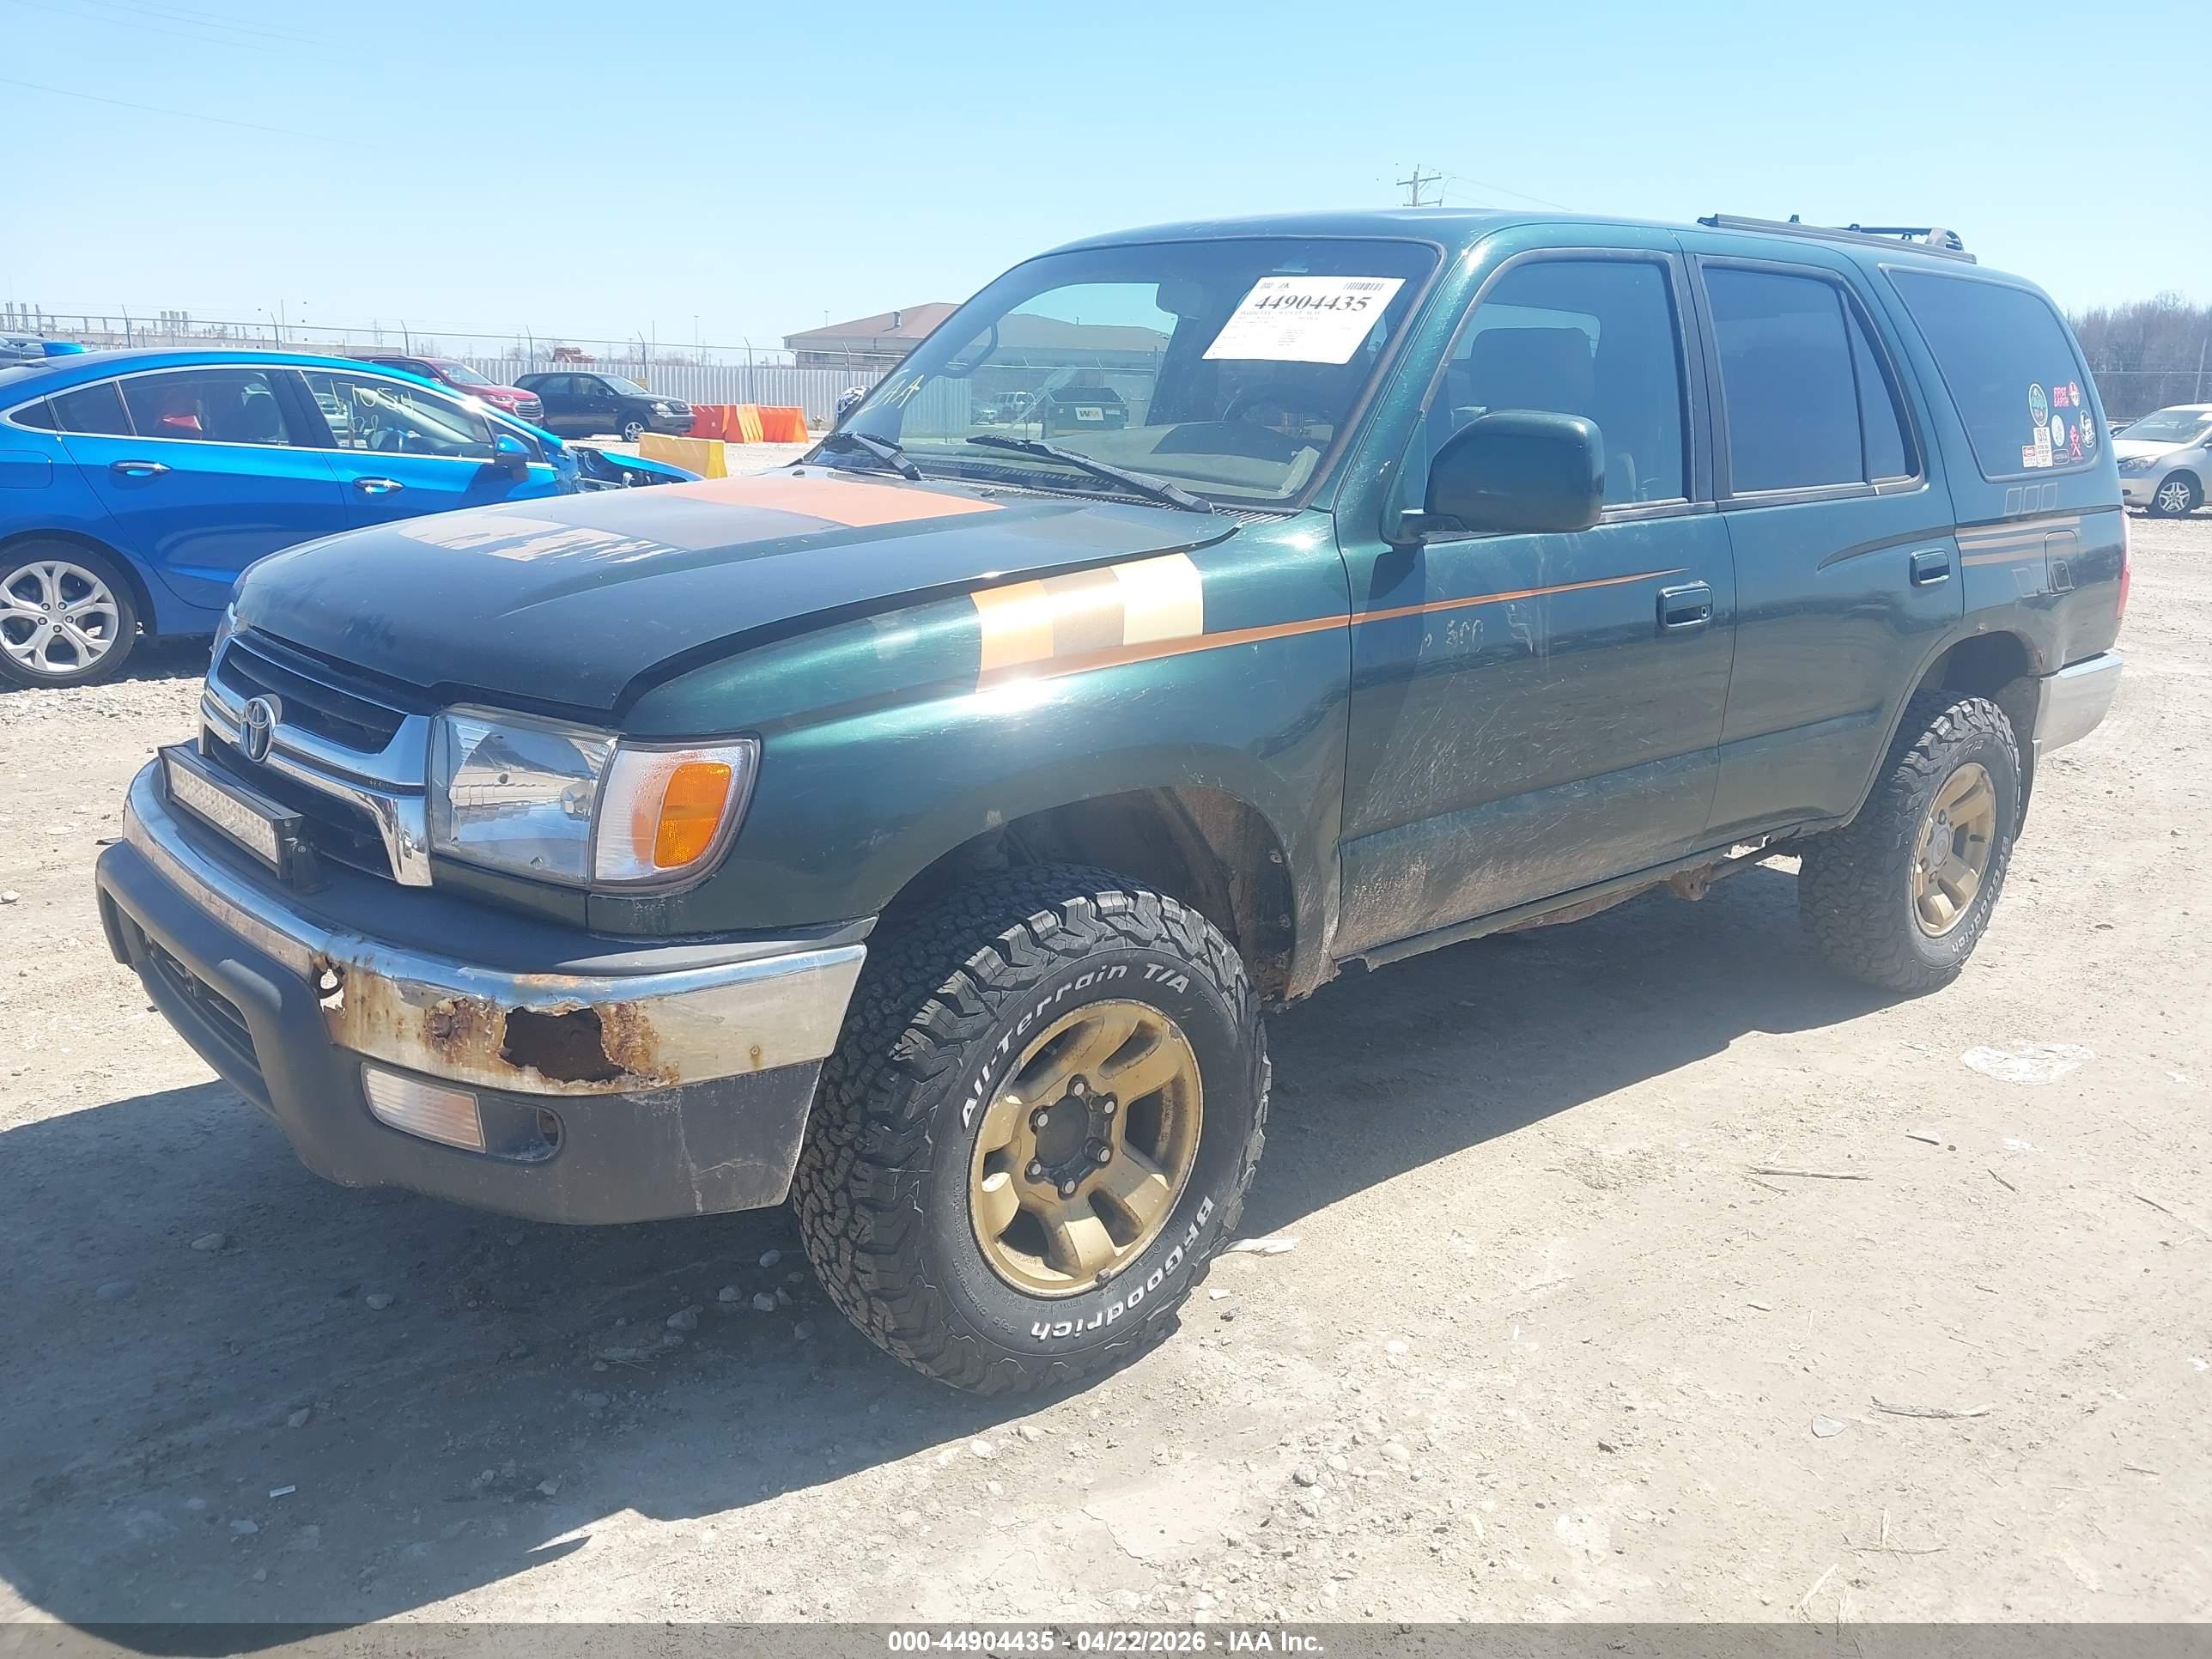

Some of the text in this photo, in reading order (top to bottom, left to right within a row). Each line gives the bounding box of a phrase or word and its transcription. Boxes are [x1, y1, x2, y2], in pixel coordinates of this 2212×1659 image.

[1255, 295, 1372, 312] 44904435
[1951, 836, 2010, 954] BFGoodrich
[962, 964, 1127, 1129] All-Terrain
[1143, 963, 1190, 994] T/A
[1030, 1195, 1215, 1340] BFGoodrich
